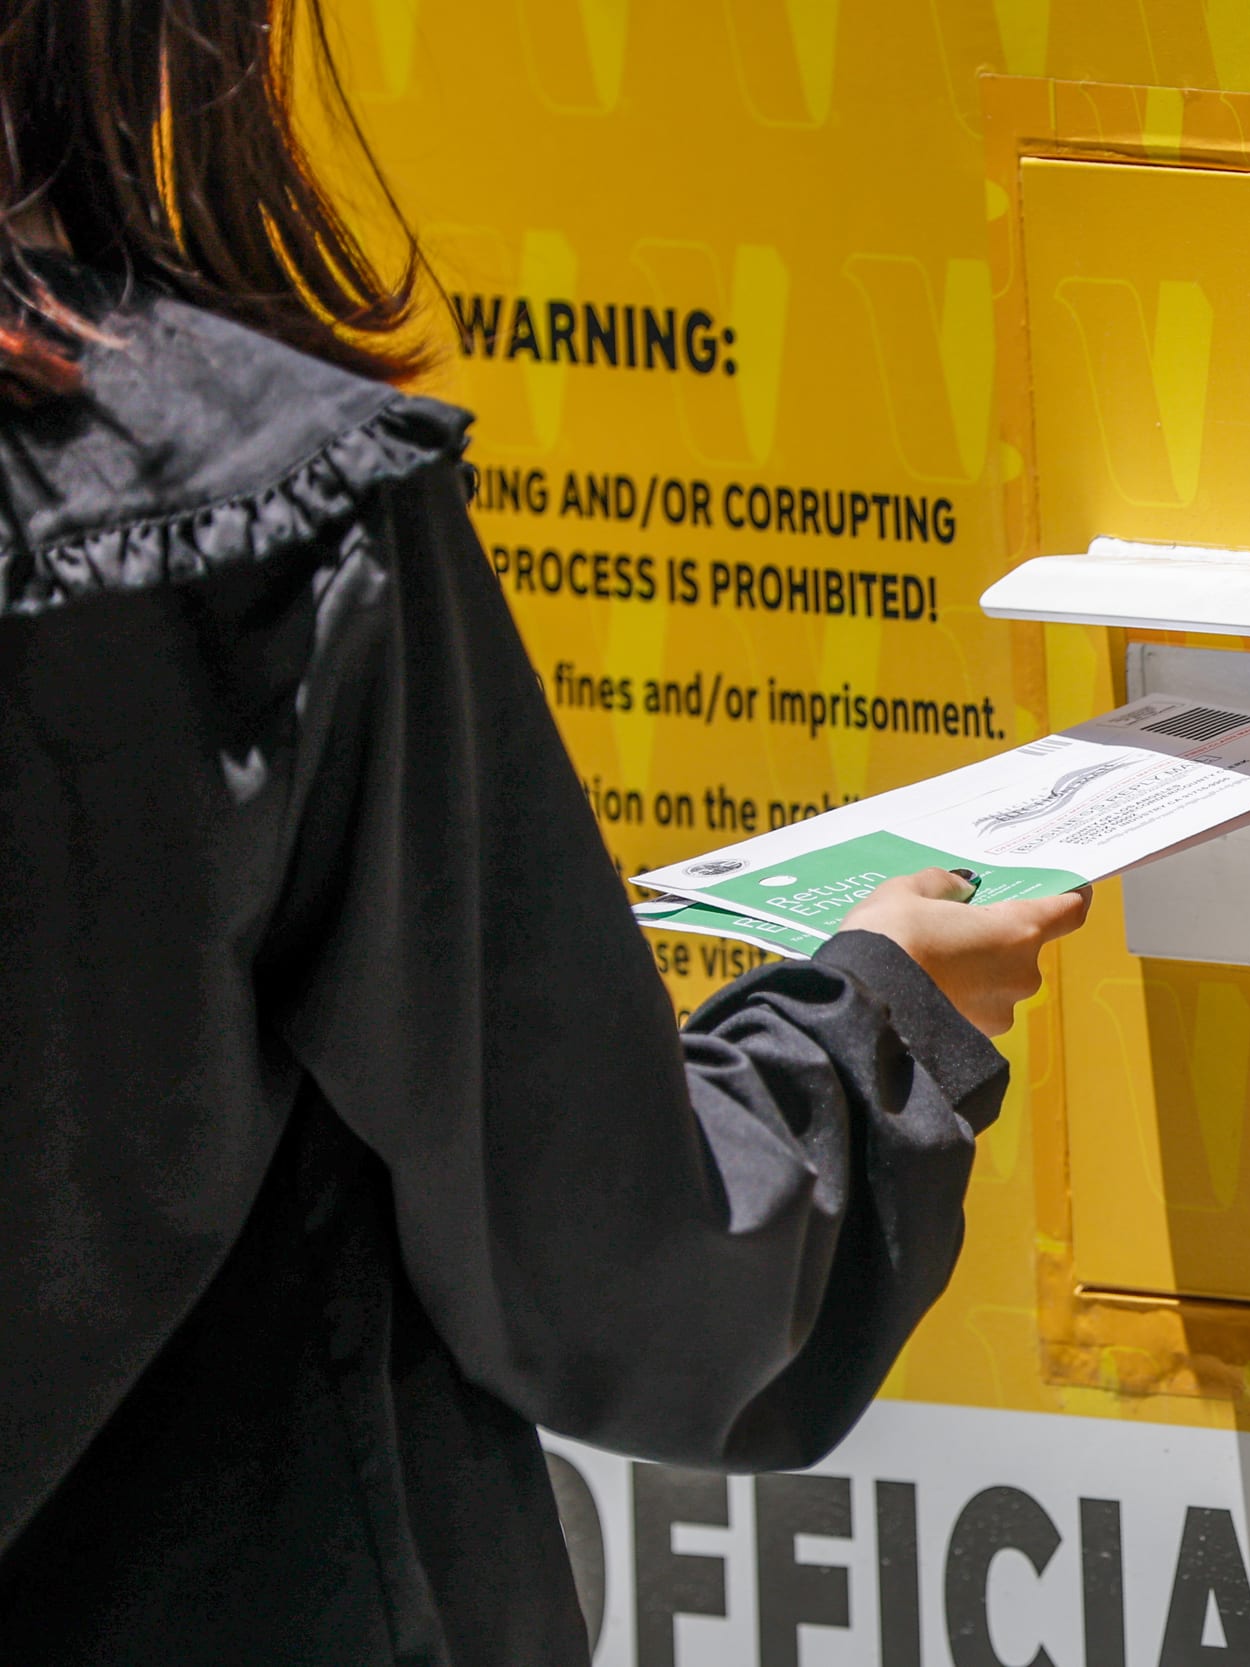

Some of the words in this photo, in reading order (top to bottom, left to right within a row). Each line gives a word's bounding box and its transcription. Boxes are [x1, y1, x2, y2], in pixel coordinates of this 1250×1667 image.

[453, 293, 736, 377] WARNING:
[560, 472, 712, 530] AND/OR
[723, 483, 957, 544] CORRUPTING
[493, 545, 655, 601] PROCESS
[667, 558, 698, 605] IS
[711, 561, 938, 623] PROHIBITED!
[554, 661, 633, 712] fines
[645, 670, 757, 726] and/or
[768, 679, 1006, 741] imprisonment.
[655, 790, 695, 828] on
[705, 787, 757, 832] the
[766, 871, 888, 909] Return
